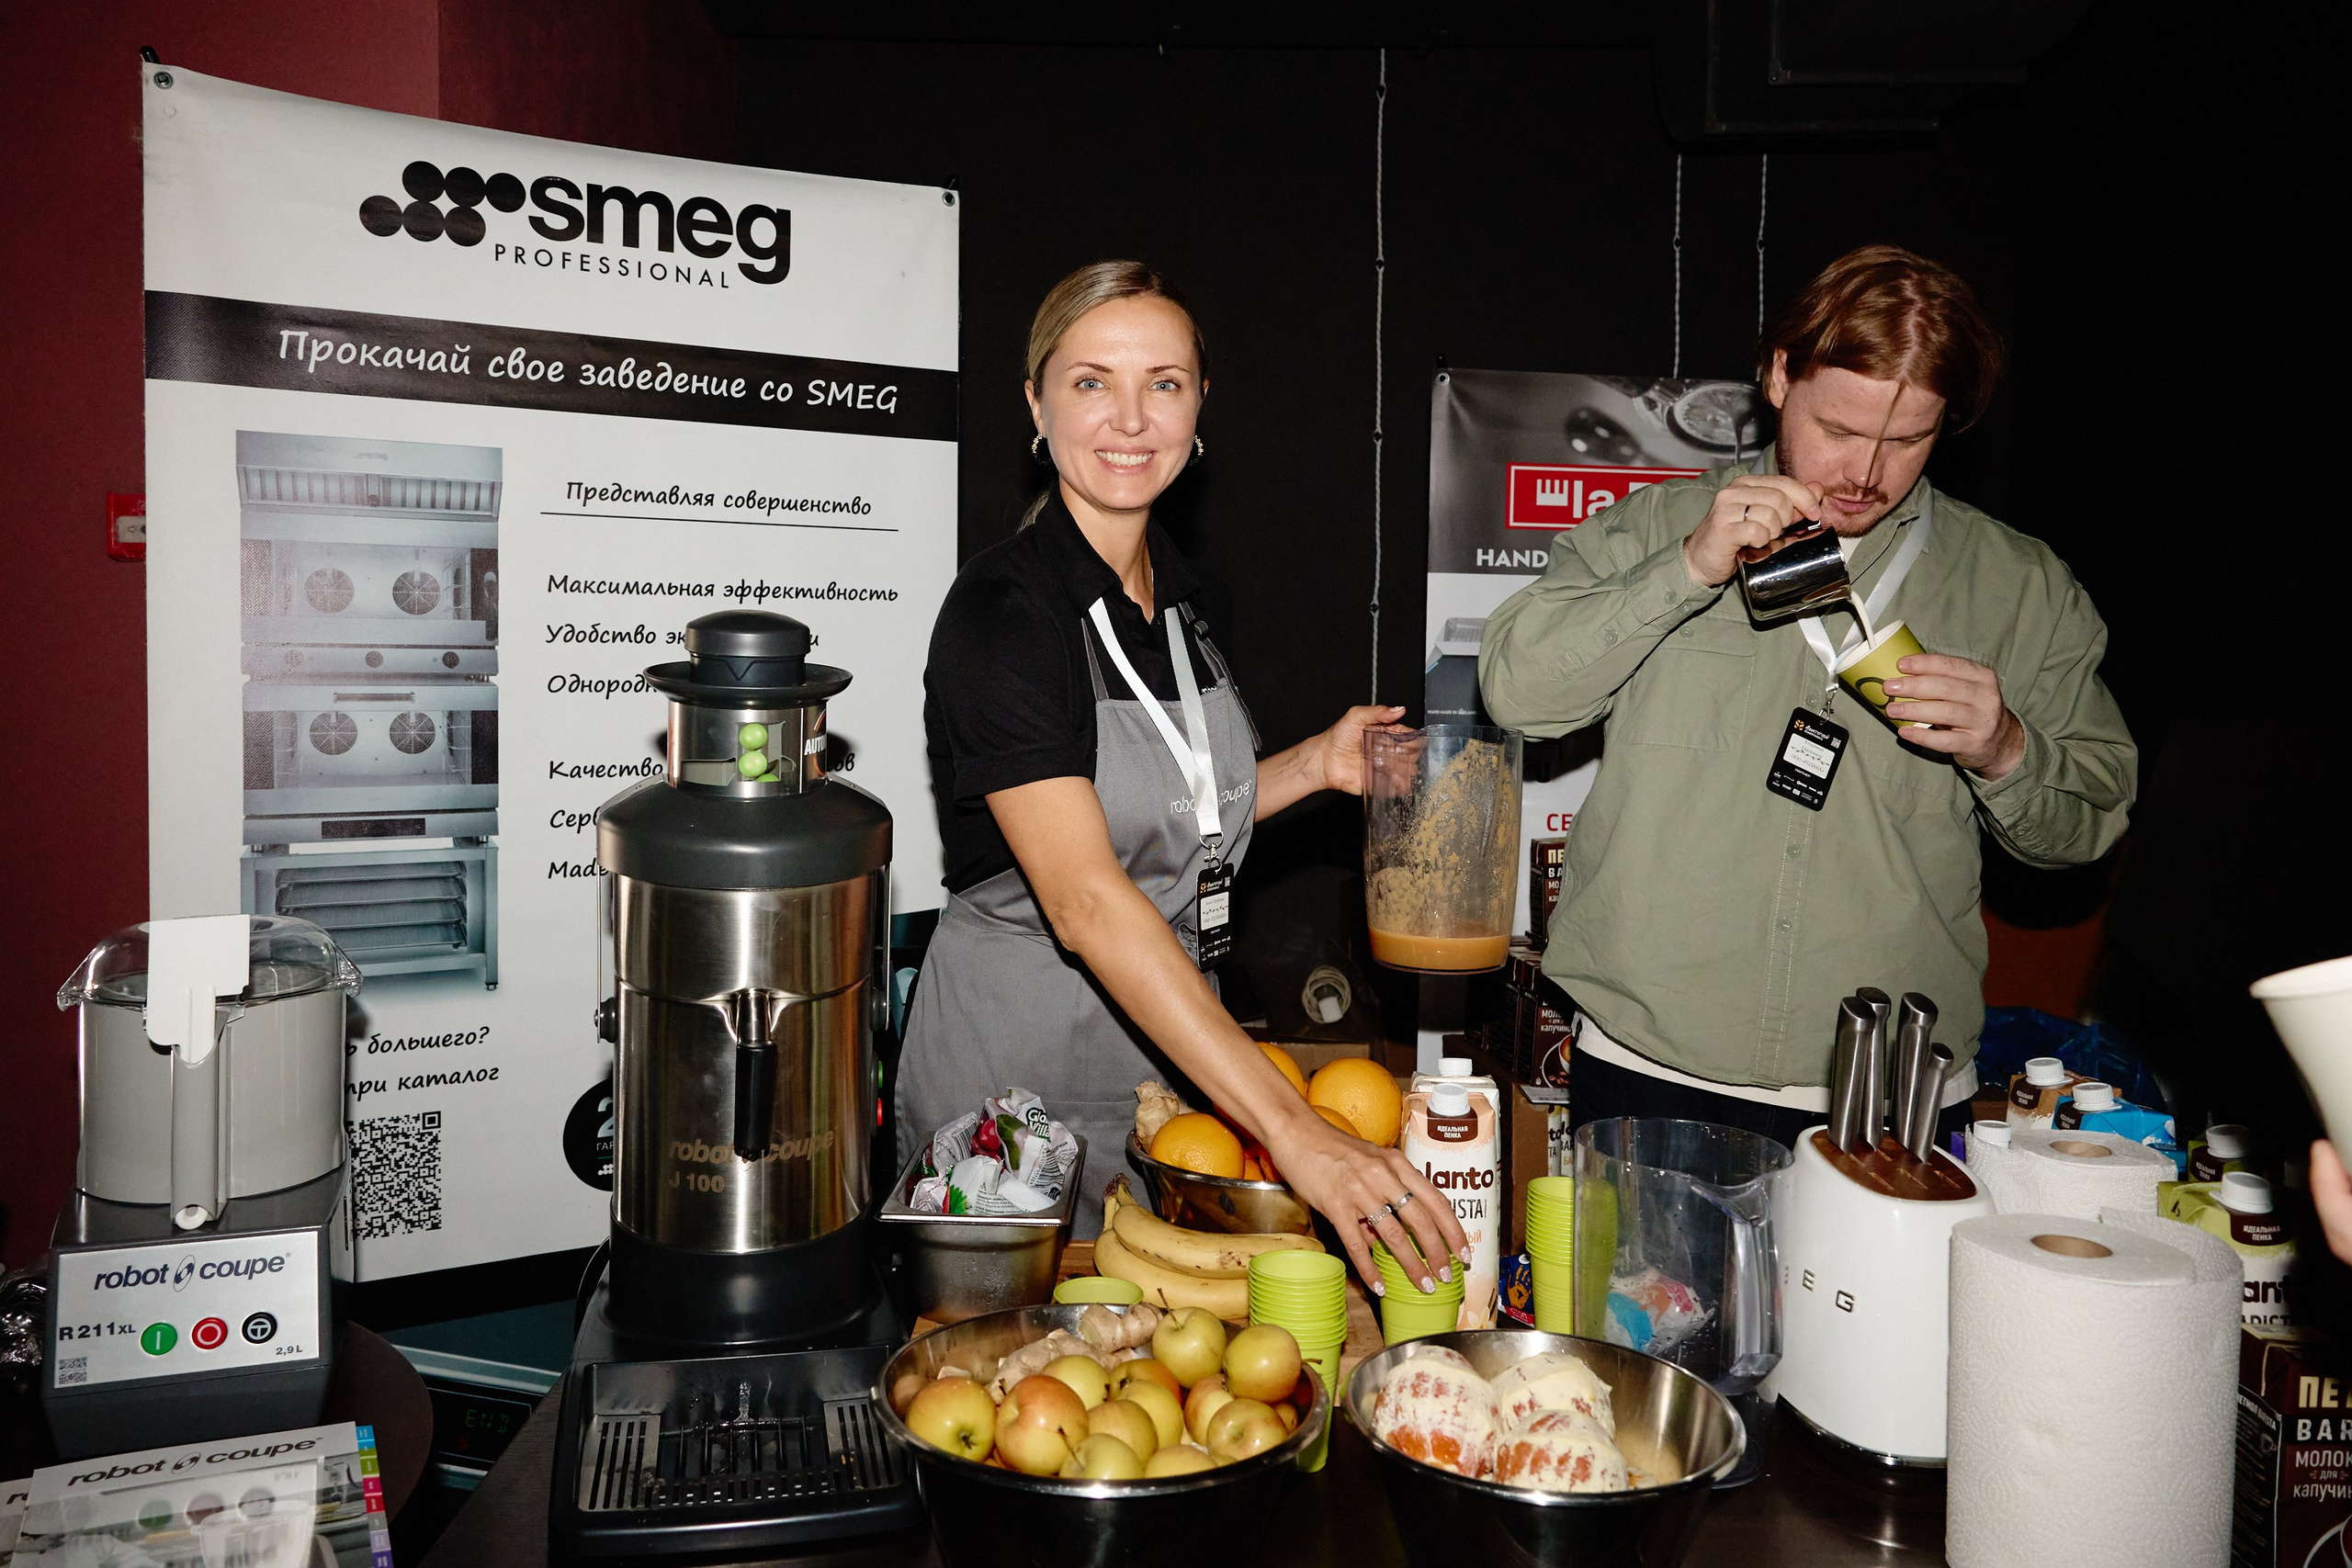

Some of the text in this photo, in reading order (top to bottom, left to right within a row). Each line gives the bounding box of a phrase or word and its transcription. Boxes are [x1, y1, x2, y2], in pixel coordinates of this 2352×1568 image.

[528, 175, 791, 286] smeg
[493, 243, 731, 289] PROFESSIONAL
[278, 327, 899, 414] Прокачай свое заведение со SMEG
[566, 481, 872, 516] Представляя совершенство
[1476, 548, 1549, 568] HAND
[548, 574, 899, 604] Максимальная эффективность
[546, 624, 657, 645] Удобство
[548, 674, 658, 699] Однород
[549, 760, 663, 780] Качество
[1170, 795, 1195, 814] robo
[368, 1026, 490, 1055] большего?
[398, 1066, 500, 1090] каталог
[1424, 1161, 1494, 1190] lanto
[2244, 1225, 2280, 1234] ИДЕАЛЬНАЯ
[94, 1263, 169, 1292] robot
[67, 1459, 166, 1486] robot
[2296, 1450, 2352, 1469] МОЛОК
[2320, 1471, 2338, 1481] для
